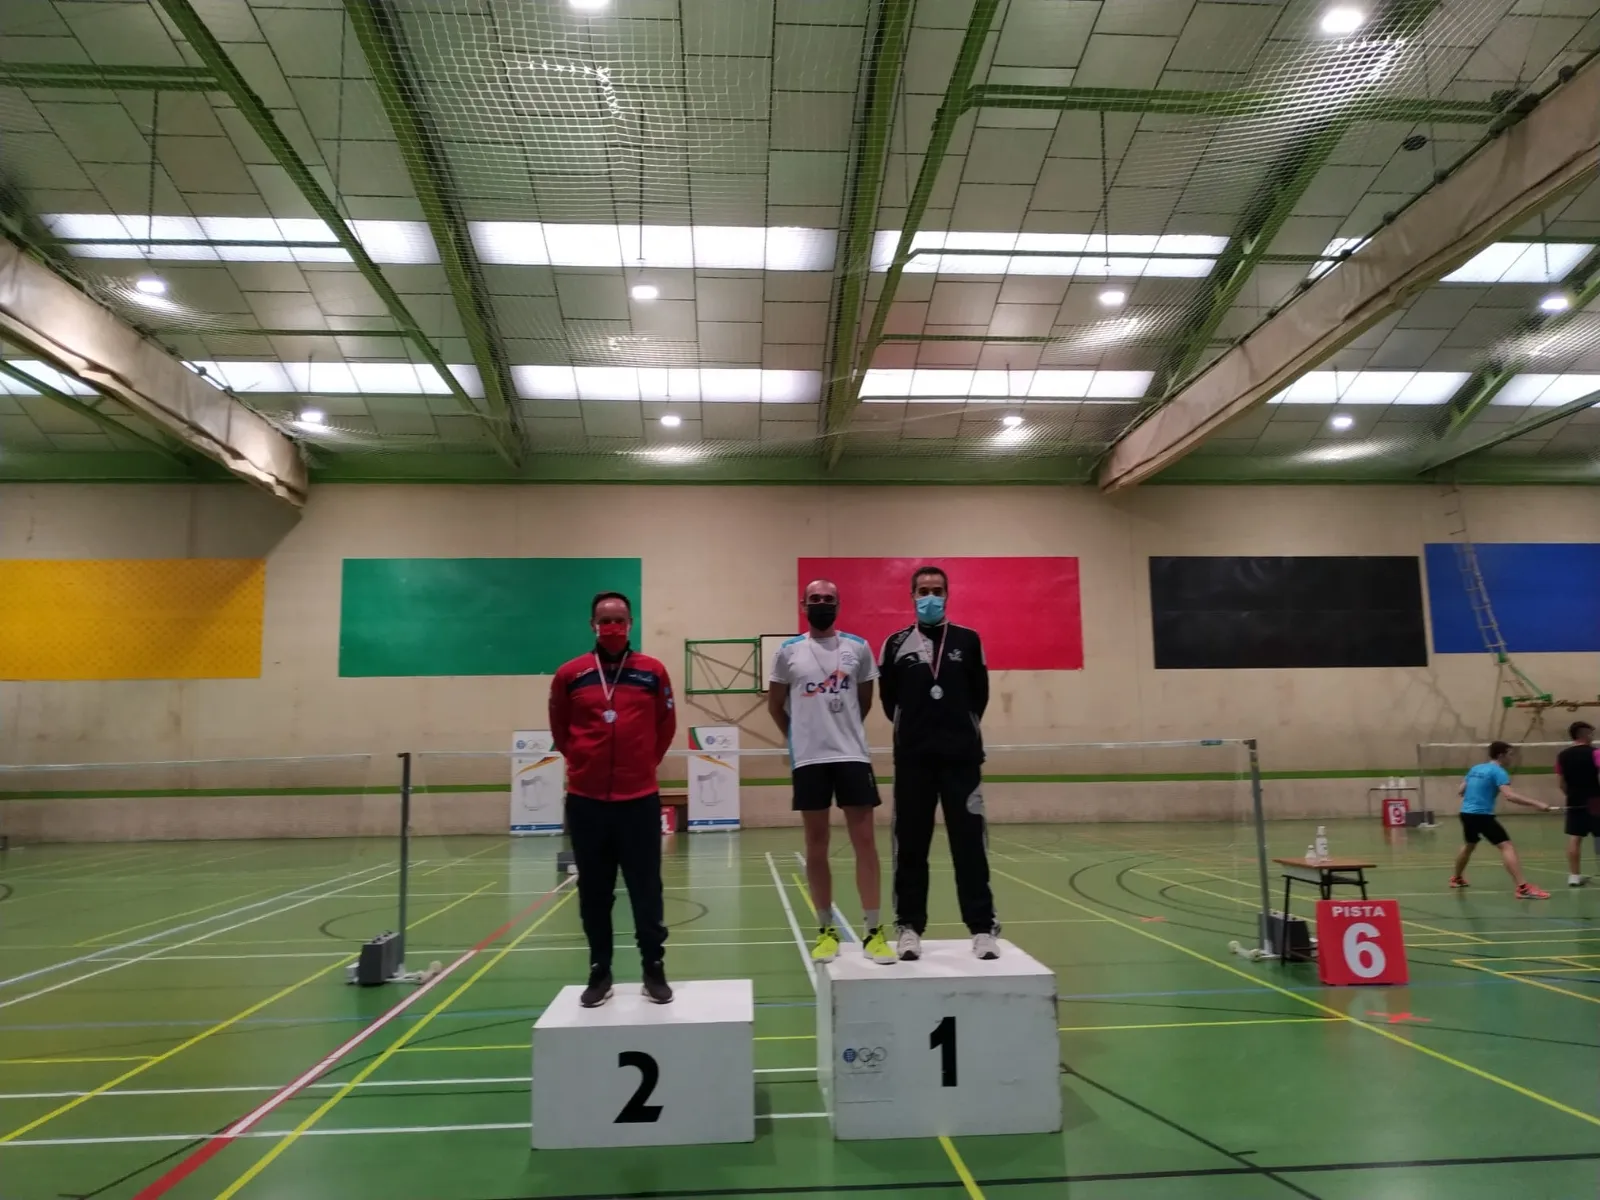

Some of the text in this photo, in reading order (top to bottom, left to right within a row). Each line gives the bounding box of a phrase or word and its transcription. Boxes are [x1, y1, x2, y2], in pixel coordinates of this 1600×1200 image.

[1392, 807, 1404, 823] 9
[1331, 906, 1386, 918] PISTA
[1342, 922, 1386, 978] 6
[929, 1016, 957, 1087] 1
[612, 1051, 664, 1123] 2
